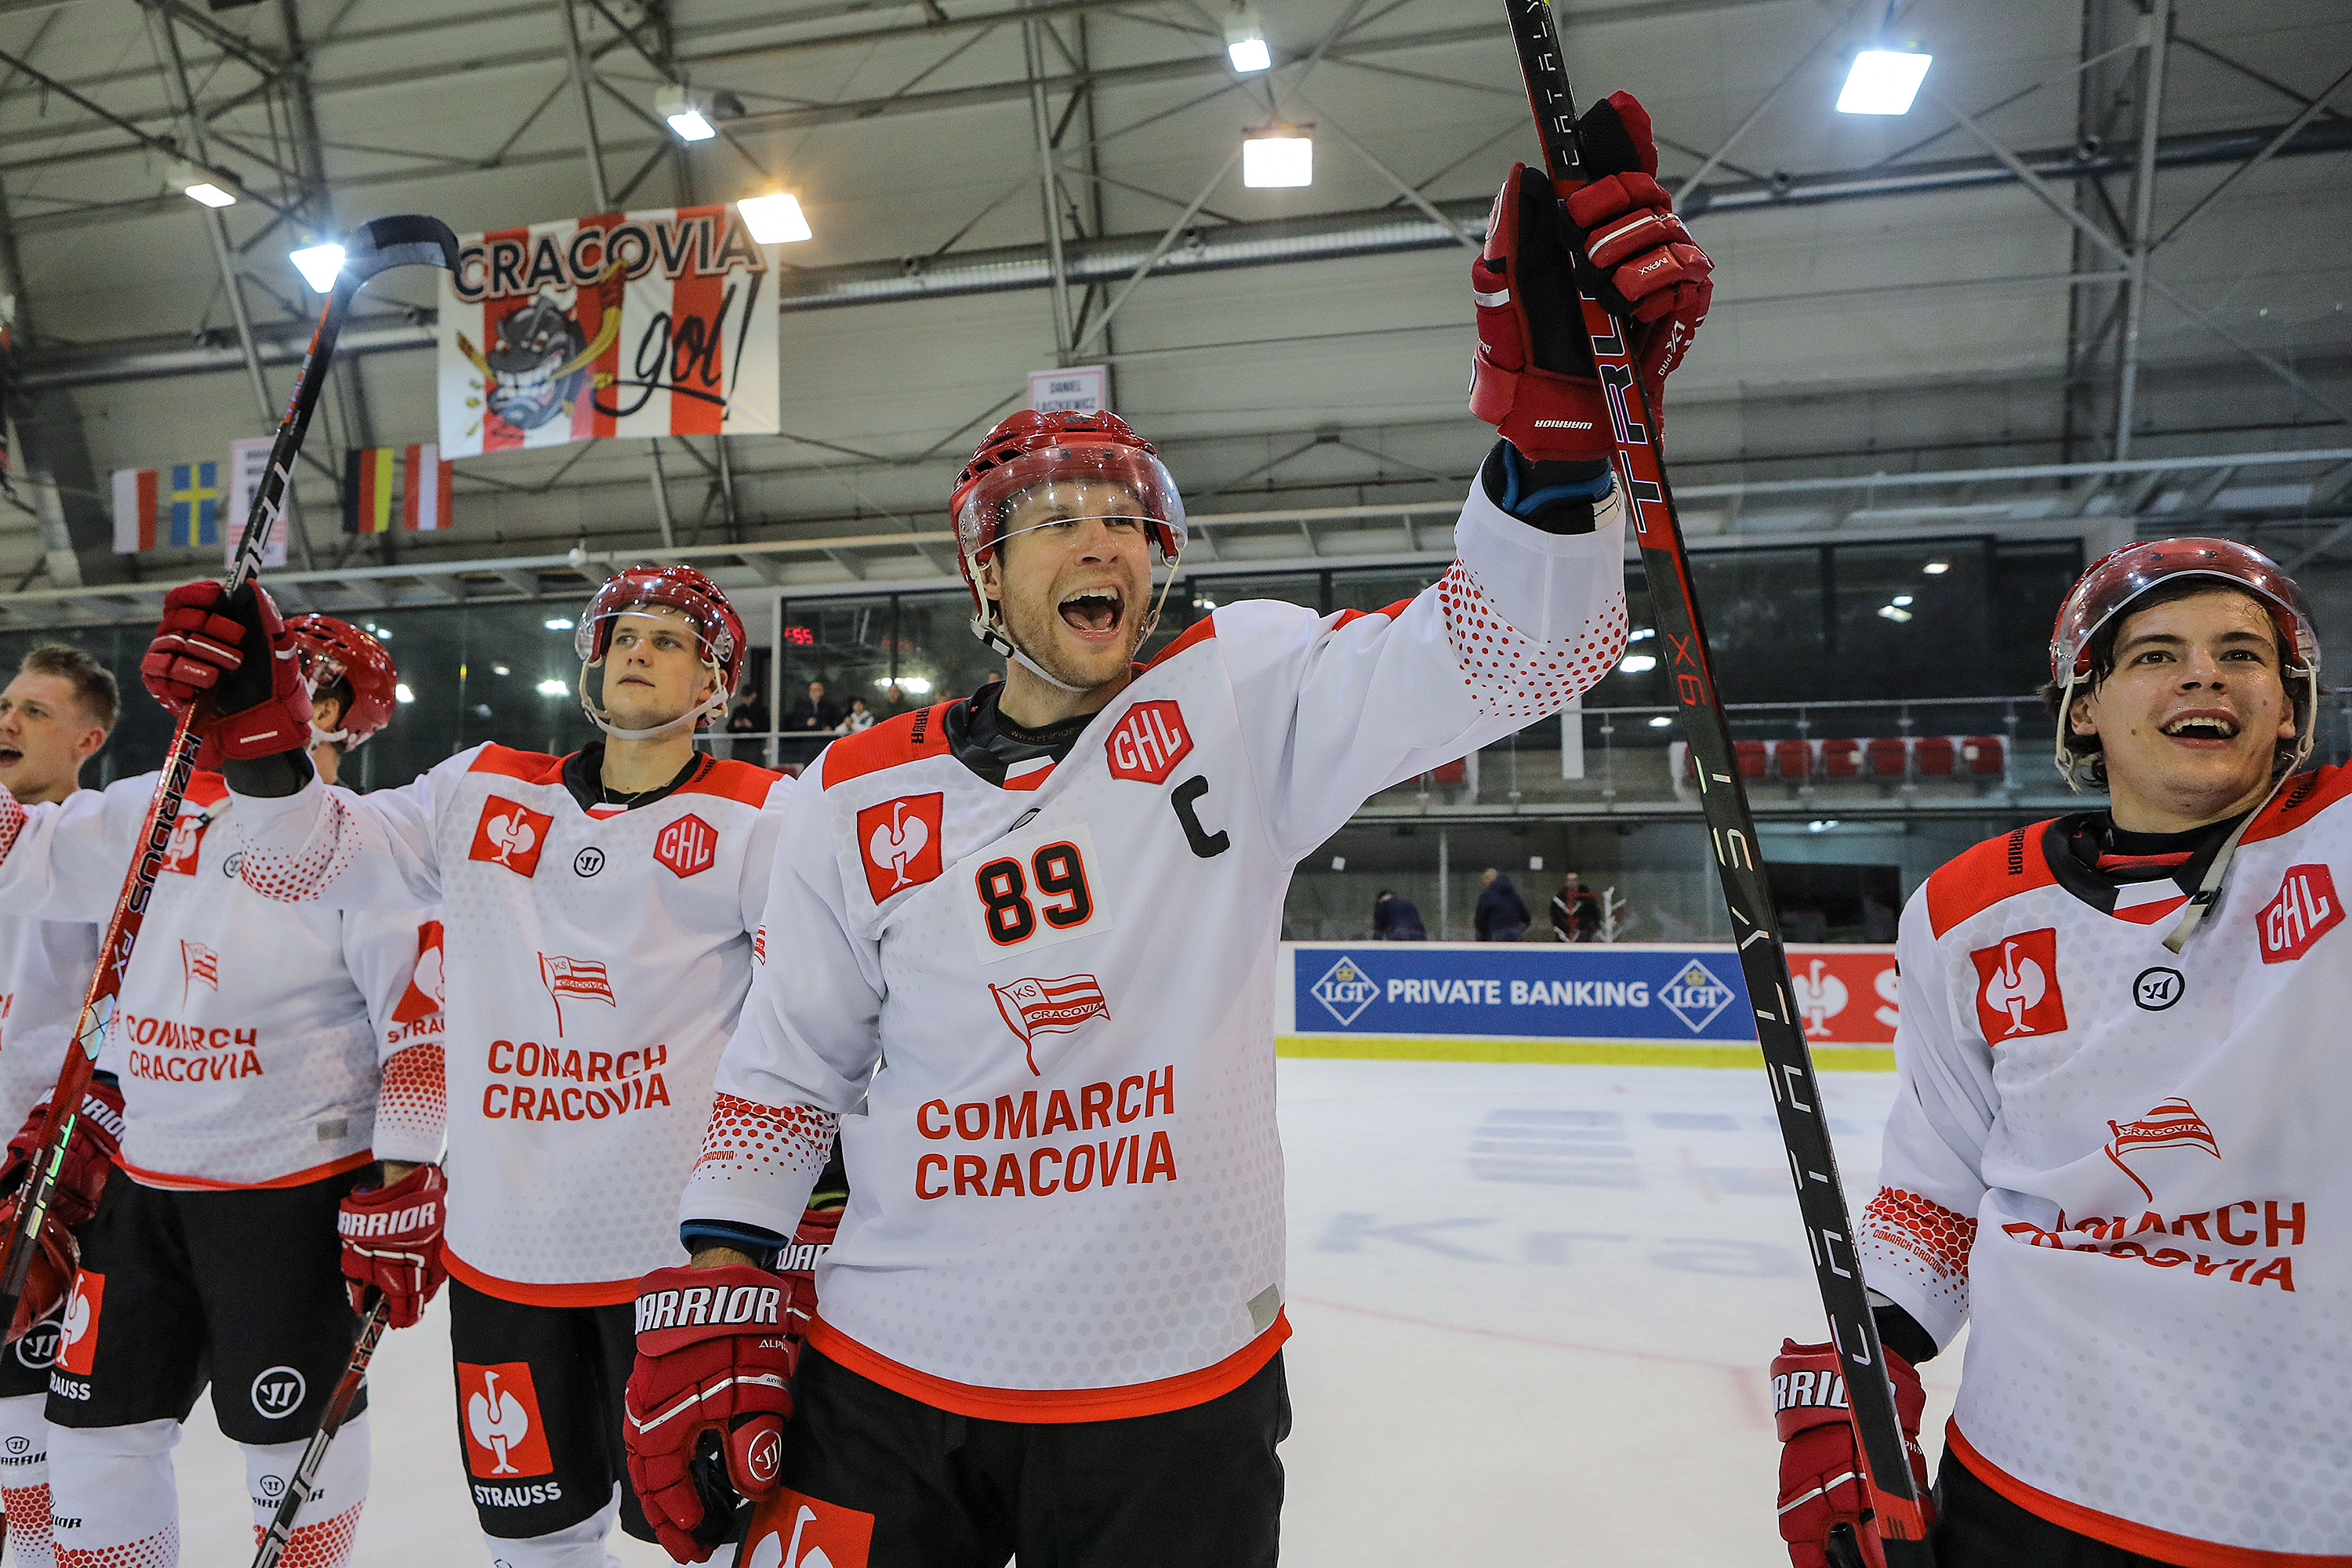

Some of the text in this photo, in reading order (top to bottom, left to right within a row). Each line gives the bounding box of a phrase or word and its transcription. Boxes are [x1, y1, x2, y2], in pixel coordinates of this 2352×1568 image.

[452, 213, 768, 302] CRACOVIA
[1639, 257, 1669, 276] IMPAX
[1658, 354, 1673, 376] PRO
[1534, 419, 1593, 430] WARRIOR
[1113, 708, 1183, 772] CHL
[1171, 775, 1230, 858] C
[661, 826, 710, 869] CHL
[2008, 826, 2028, 876] ARRIOR
[975, 840, 1094, 946] 89
[2266, 873, 2331, 951] CHL
[560, 979, 604, 989] CRACOVIA
[1013, 985, 1037, 1000] KS
[1323, 981, 1370, 1004] LGT
[1387, 978, 1650, 1007] PRIVATE BANKING
[1673, 985, 1722, 1008] LGT
[1031, 1004, 1101, 1020] CRACOVIA
[126, 1014, 258, 1050] COMARCH
[129, 1049, 264, 1082] CRACOVIA
[488, 1040, 668, 1083] COMARCH
[1693, 755, 1871, 1366] CATALYST
[482, 1073, 671, 1121] CRACOVIA
[916, 1064, 1175, 1140] COMARCH
[915, 1131, 1177, 1200] CRACOVIA
[337, 1201, 436, 1237] ARRIOR
[1872, 1229, 1913, 1251] COMARCH
[1913, 1246, 1948, 1279] CRACOVIA
[49, 1370, 92, 1401] RAUSS
[474, 1481, 562, 1508] STRAUSS
